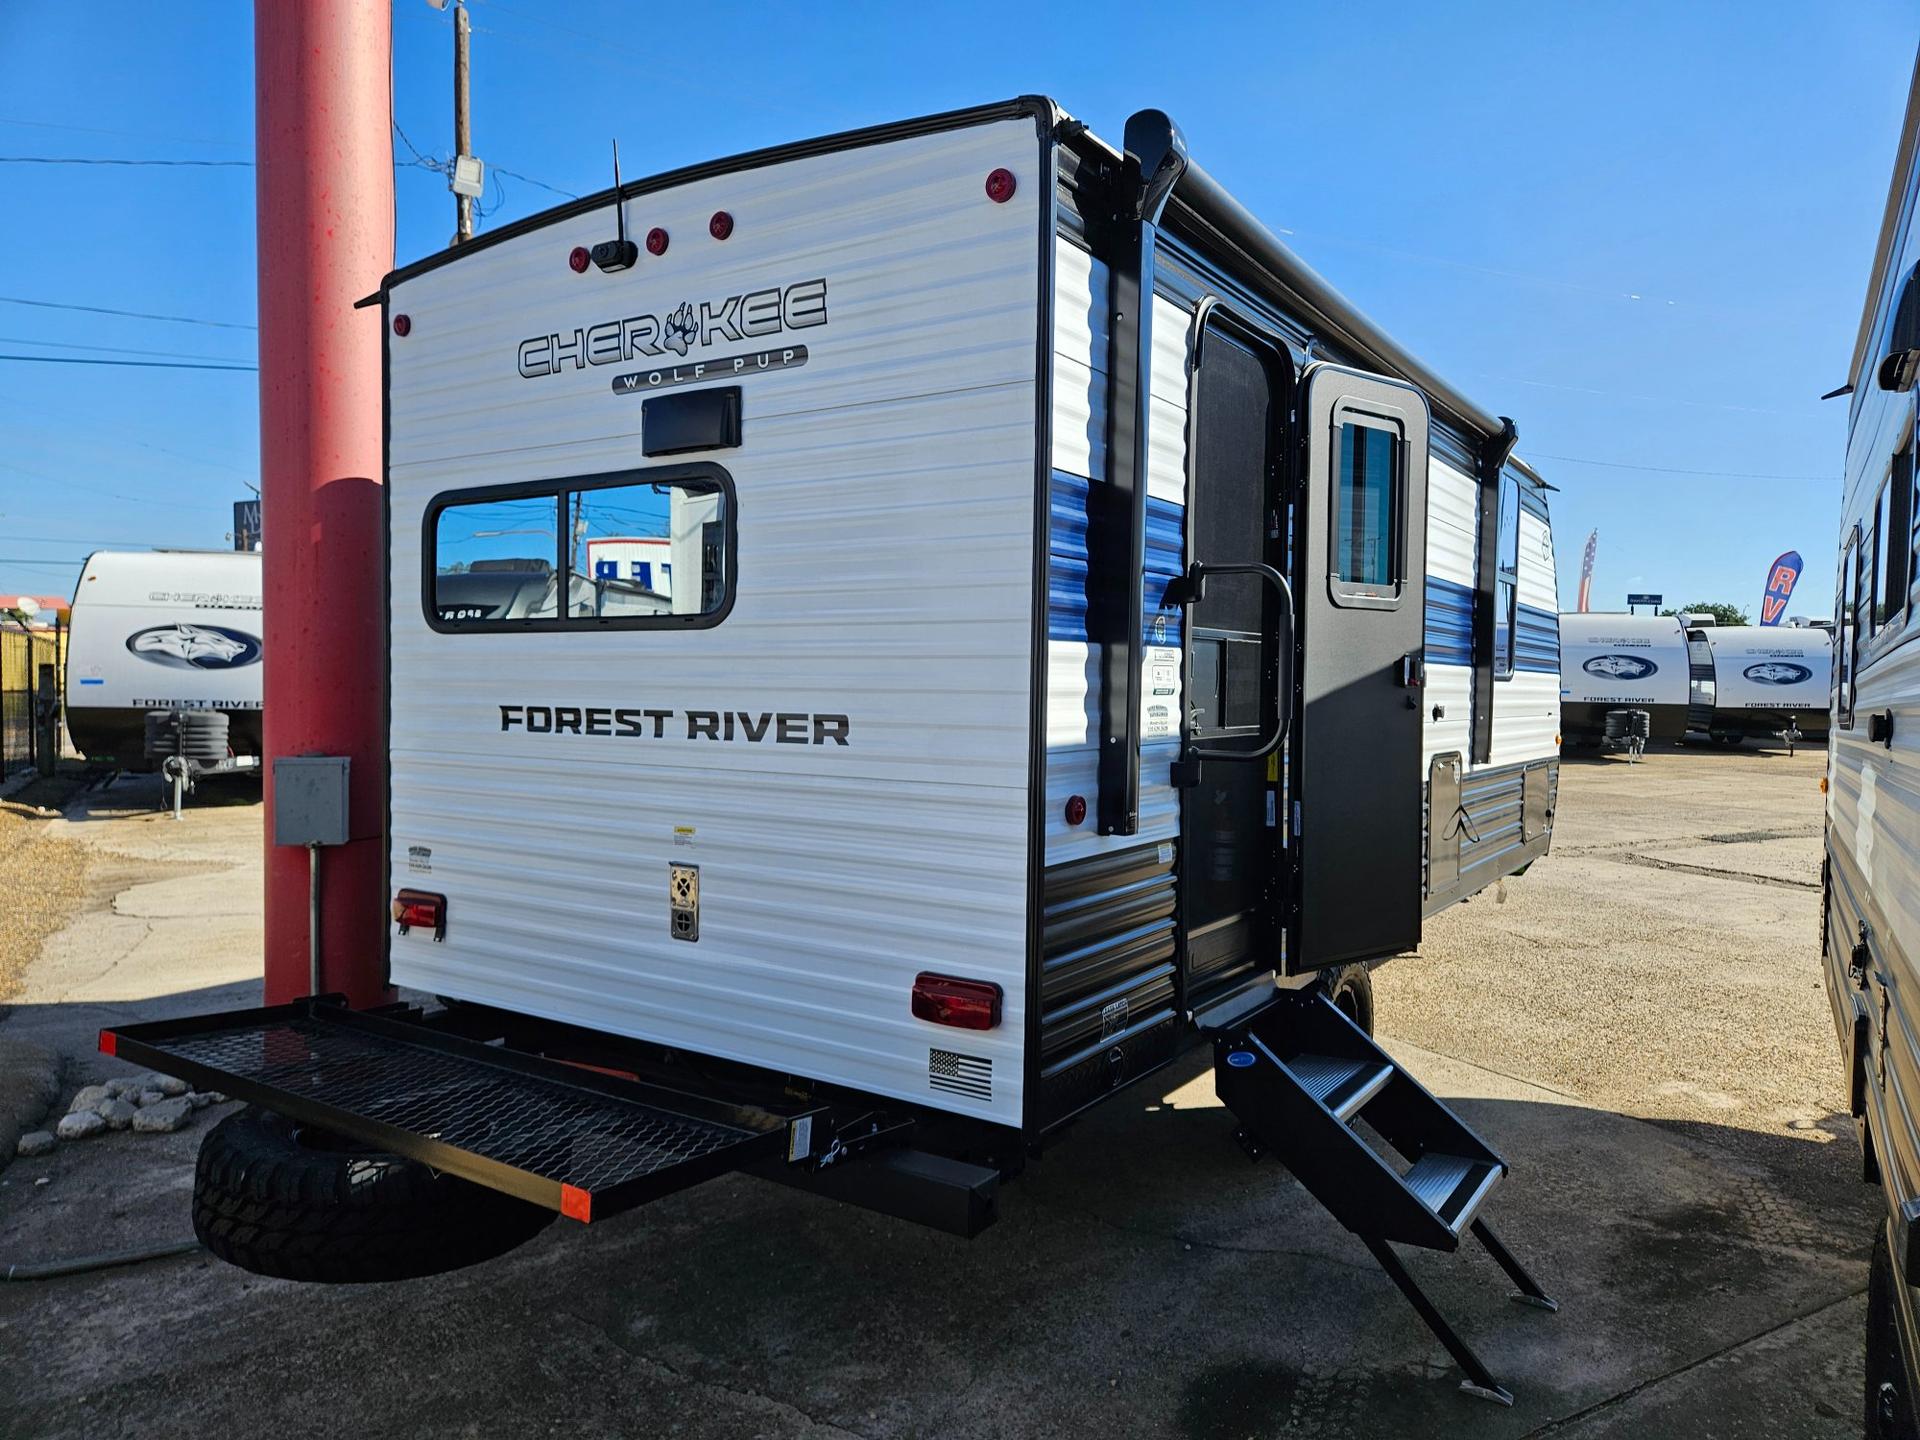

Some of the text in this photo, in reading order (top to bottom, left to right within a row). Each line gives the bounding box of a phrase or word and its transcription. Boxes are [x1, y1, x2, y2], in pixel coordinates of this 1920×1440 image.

[623, 351, 795, 389] WOLF PUP
[1763, 565, 1797, 624] RV
[132, 698, 207, 708] FOREST
[498, 704, 850, 747] FOREST RIVER
